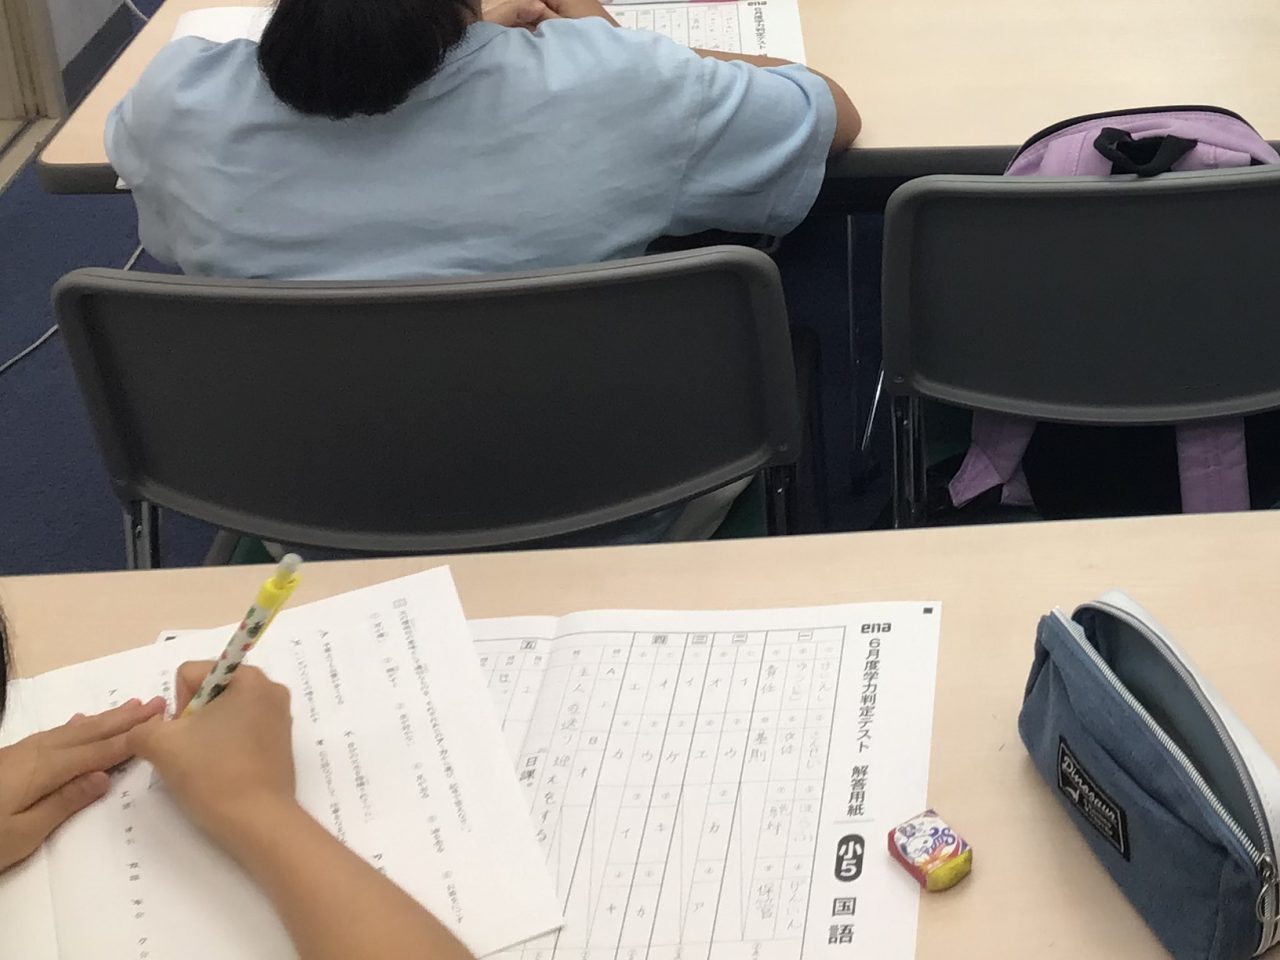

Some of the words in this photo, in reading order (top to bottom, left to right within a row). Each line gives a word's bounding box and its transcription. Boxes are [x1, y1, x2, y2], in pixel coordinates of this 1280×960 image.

[861, 622, 892, 634] ena
[857, 638, 881, 753] 6月度学力判定テスト
[846, 764, 869, 817] 解答用紙
[838, 840, 863, 877] 小5
[827, 897, 857, 945] 国語
